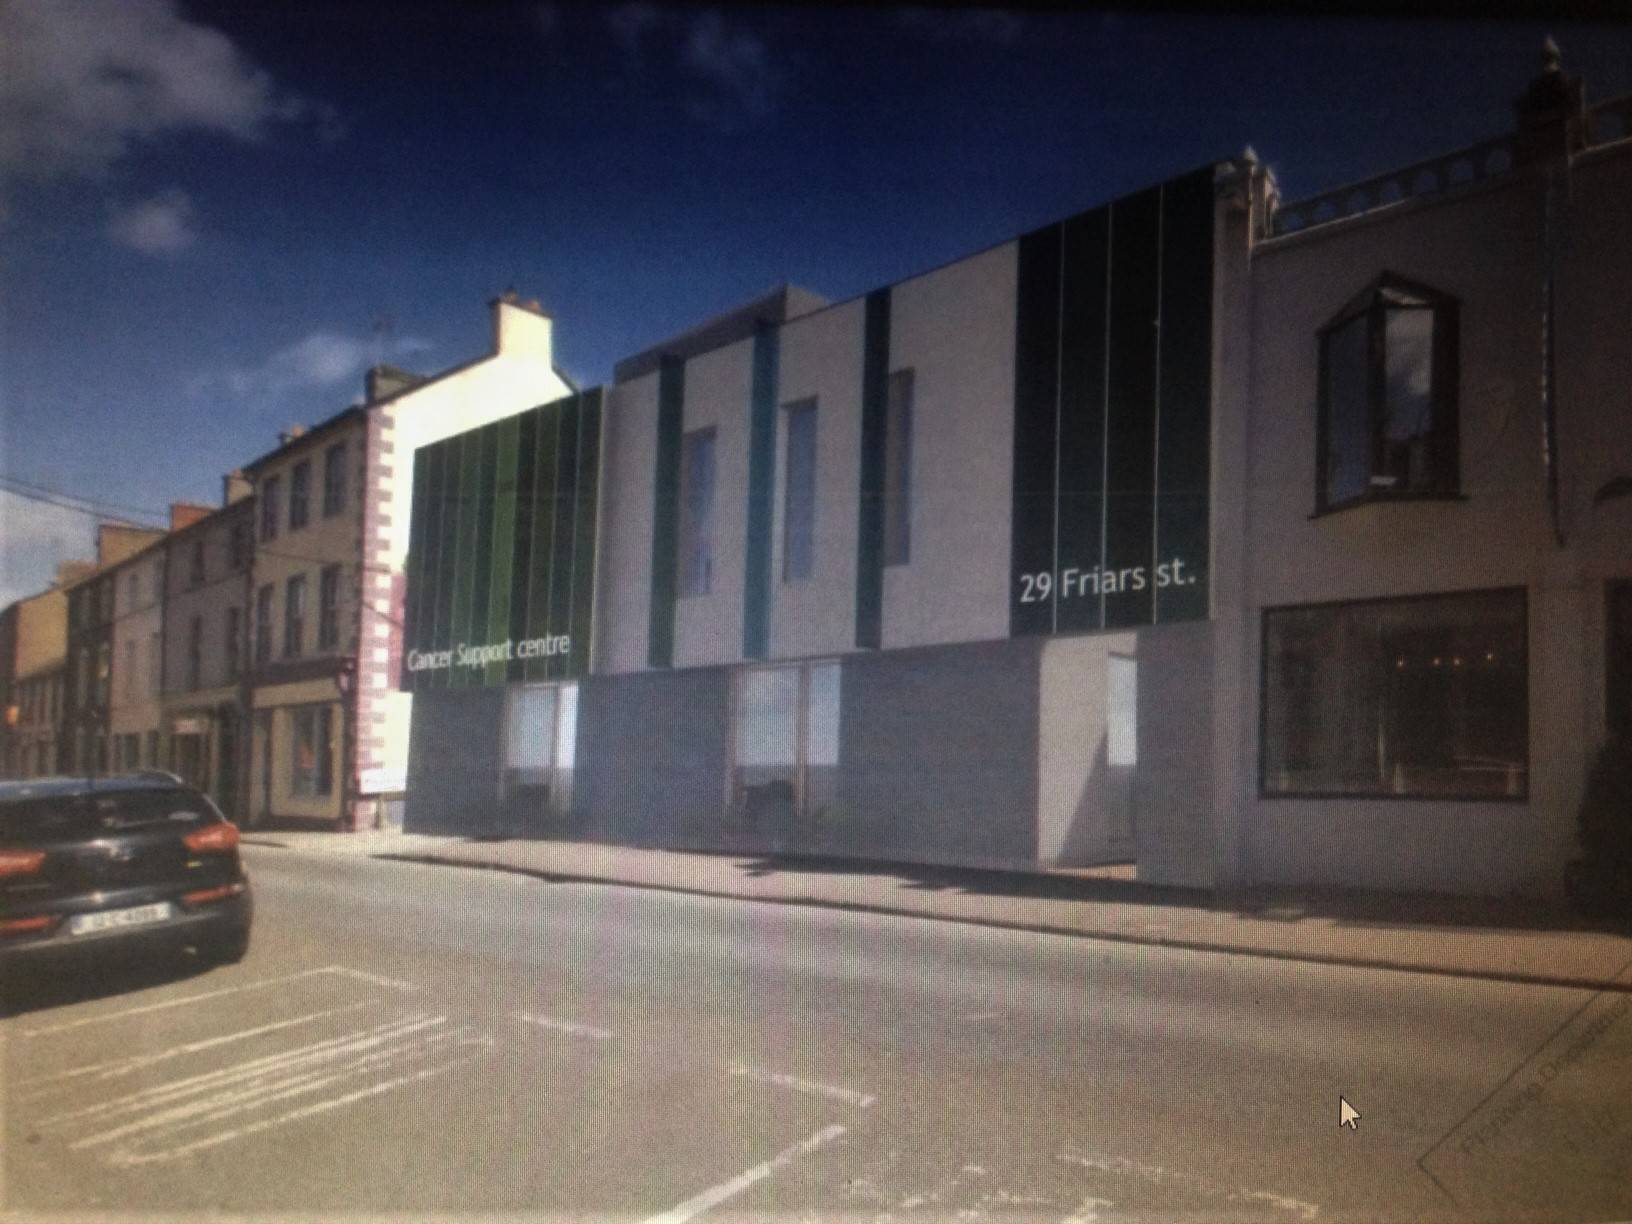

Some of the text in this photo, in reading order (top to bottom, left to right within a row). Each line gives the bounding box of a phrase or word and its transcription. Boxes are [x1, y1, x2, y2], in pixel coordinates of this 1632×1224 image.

[1019, 557, 1196, 603] 29 Friars st.
[407, 632, 570, 671] Cancer Support centre
